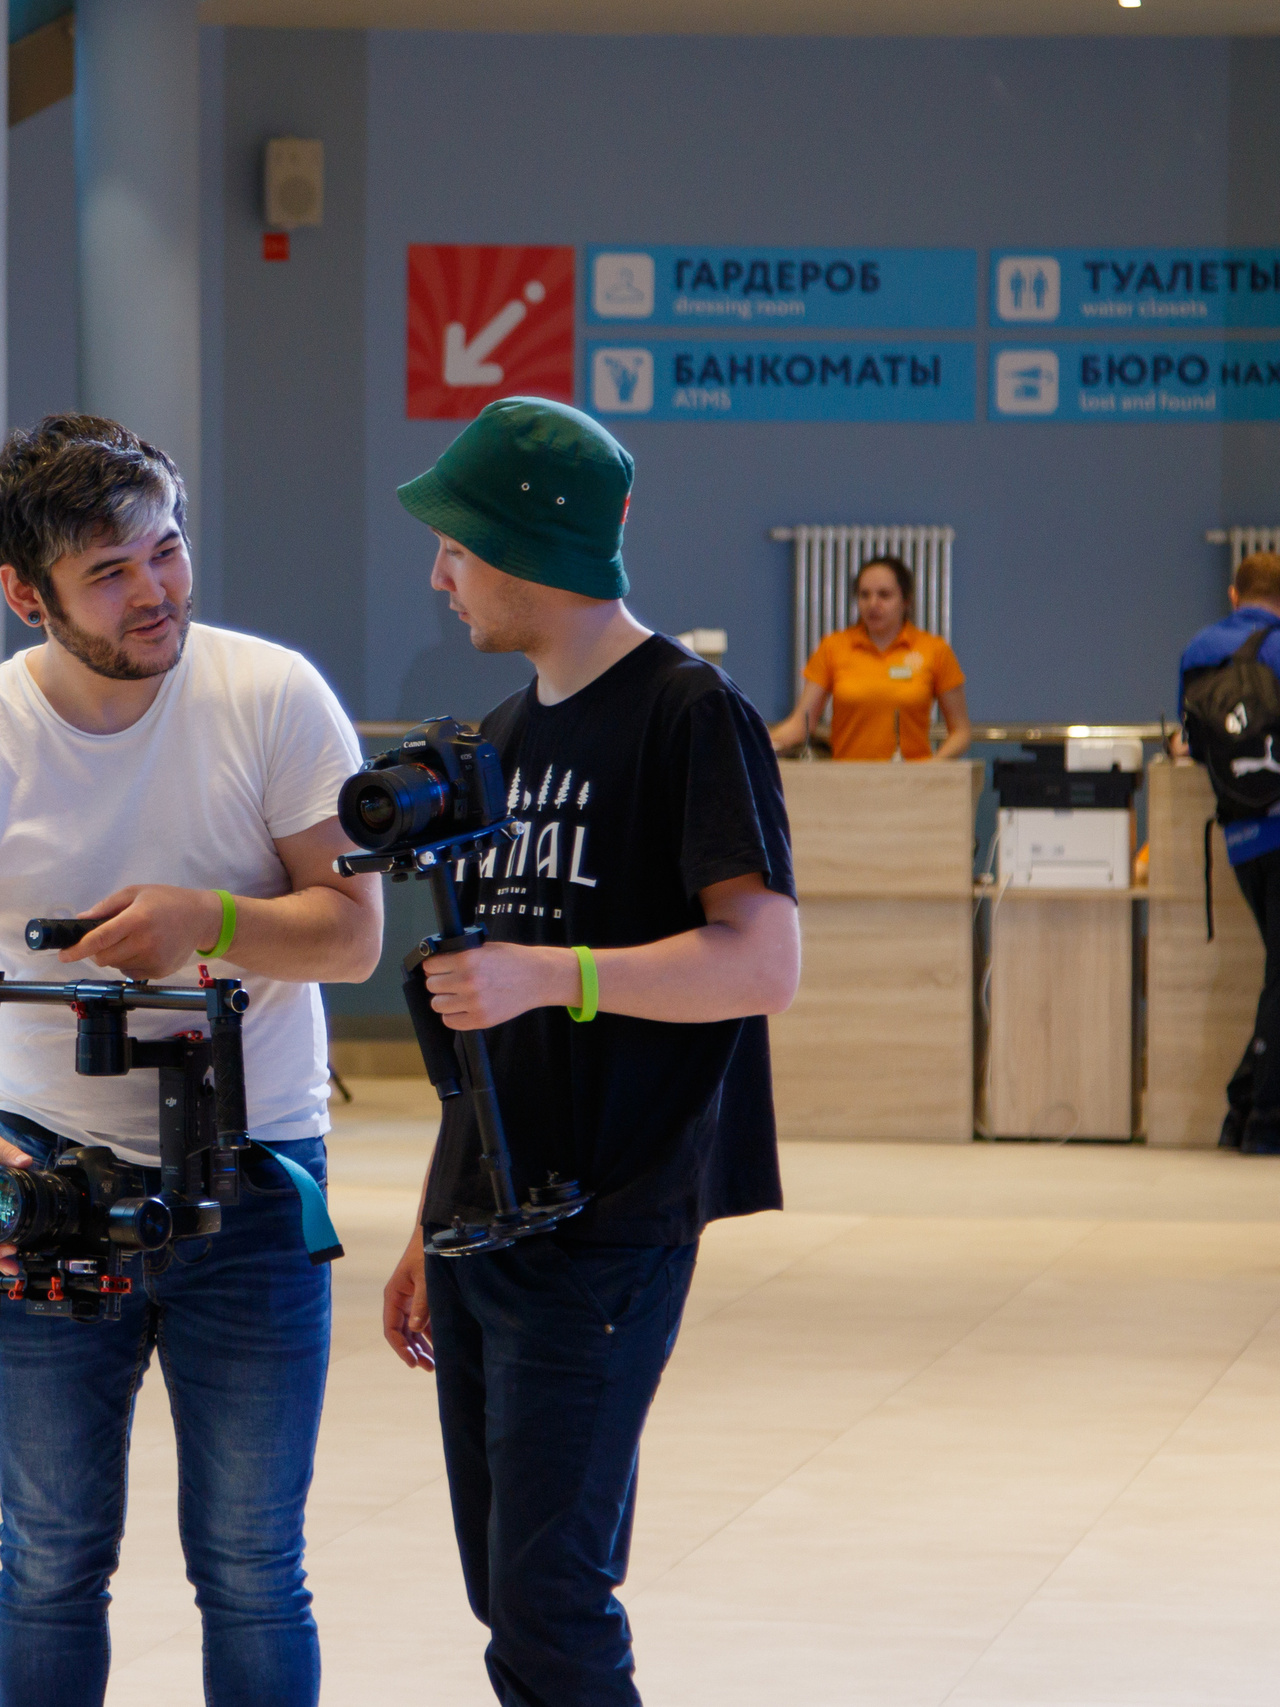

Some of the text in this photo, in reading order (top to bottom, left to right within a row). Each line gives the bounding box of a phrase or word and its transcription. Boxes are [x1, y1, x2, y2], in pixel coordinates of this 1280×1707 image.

[675, 259, 881, 296] ГАРДЕРОБ
[1084, 260, 1280, 293] ТУАЛЕТЫ
[756, 299, 806, 316] room
[674, 353, 942, 387] БАНКОМАТЫ
[1081, 353, 1210, 387] БЮРО
[1121, 391, 1157, 412] and
[1160, 391, 1217, 412] found
[403, 740, 426, 748] Canon
